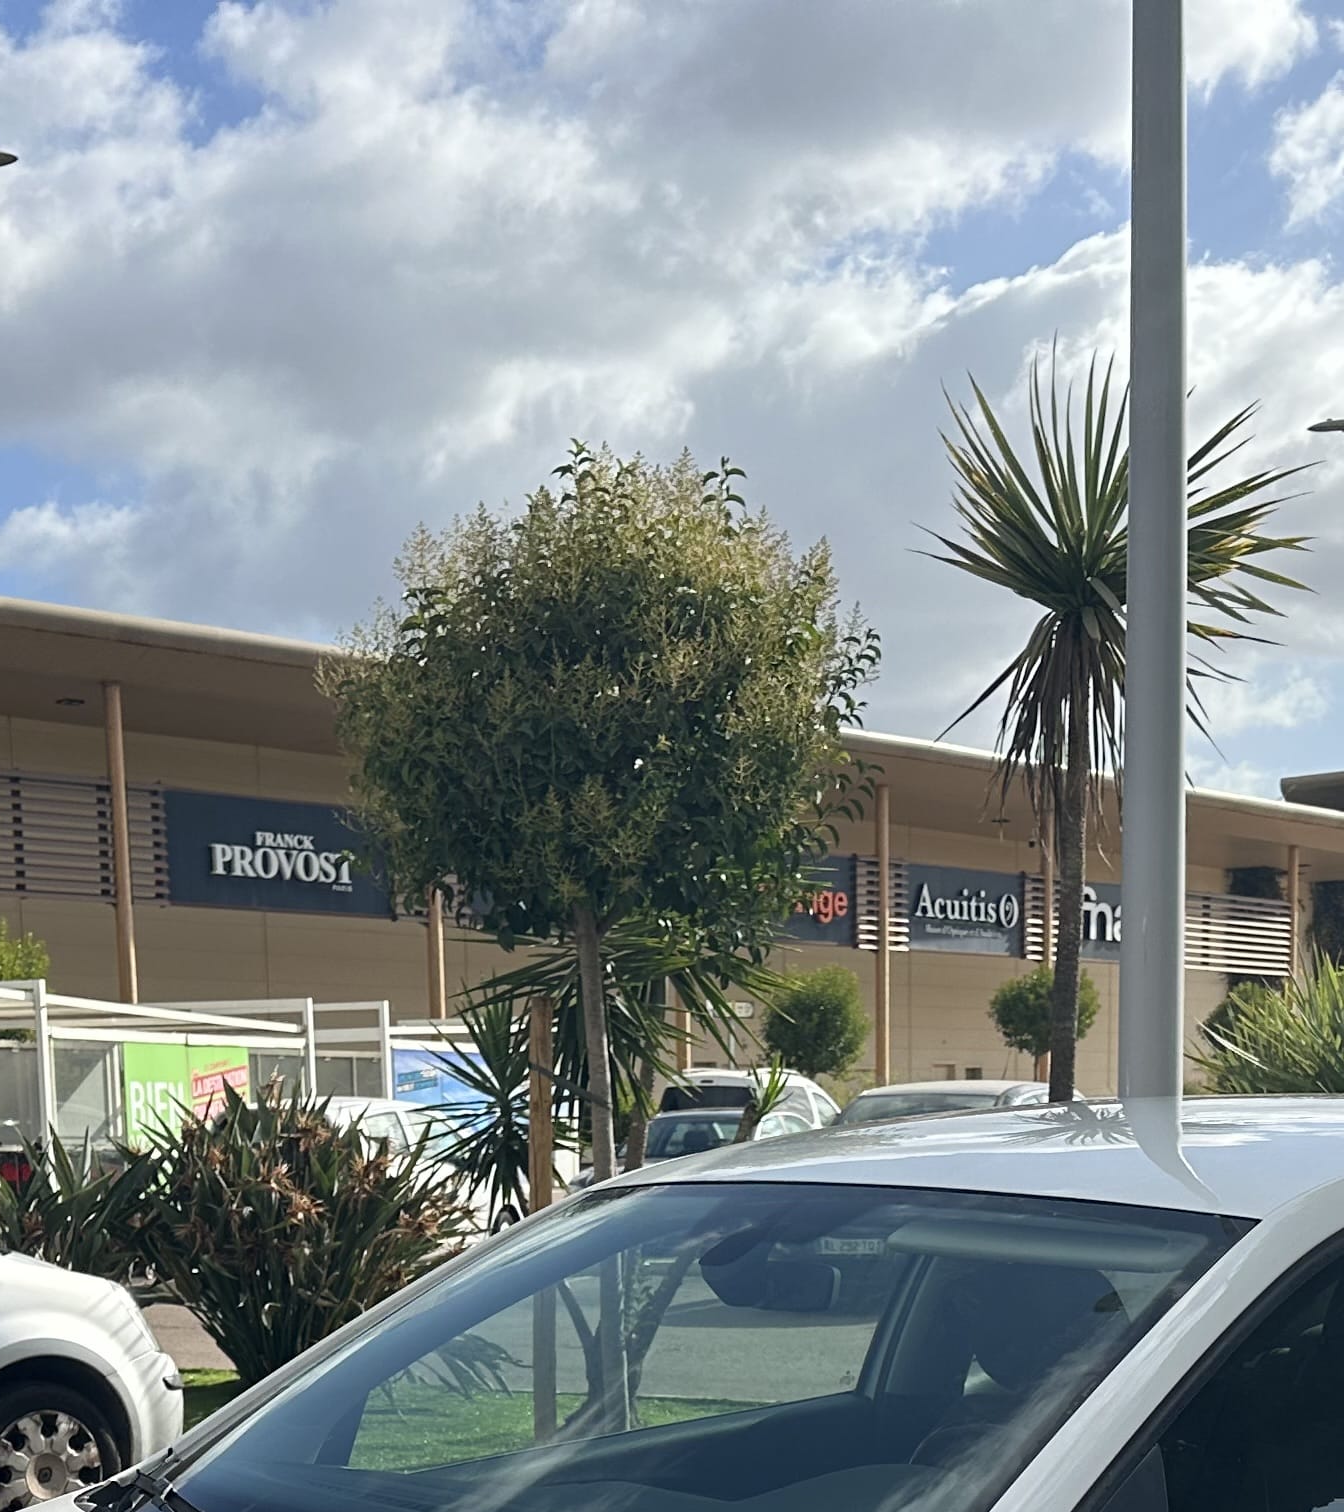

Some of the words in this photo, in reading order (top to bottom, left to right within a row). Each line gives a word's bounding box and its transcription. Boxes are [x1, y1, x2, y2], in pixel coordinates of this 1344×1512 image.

[255, 831, 315, 850] FRANCK
[209, 843, 353, 884] PROVOST
[915, 882, 997, 923] Acuitis
[129, 1081, 184, 1132] BIEN
